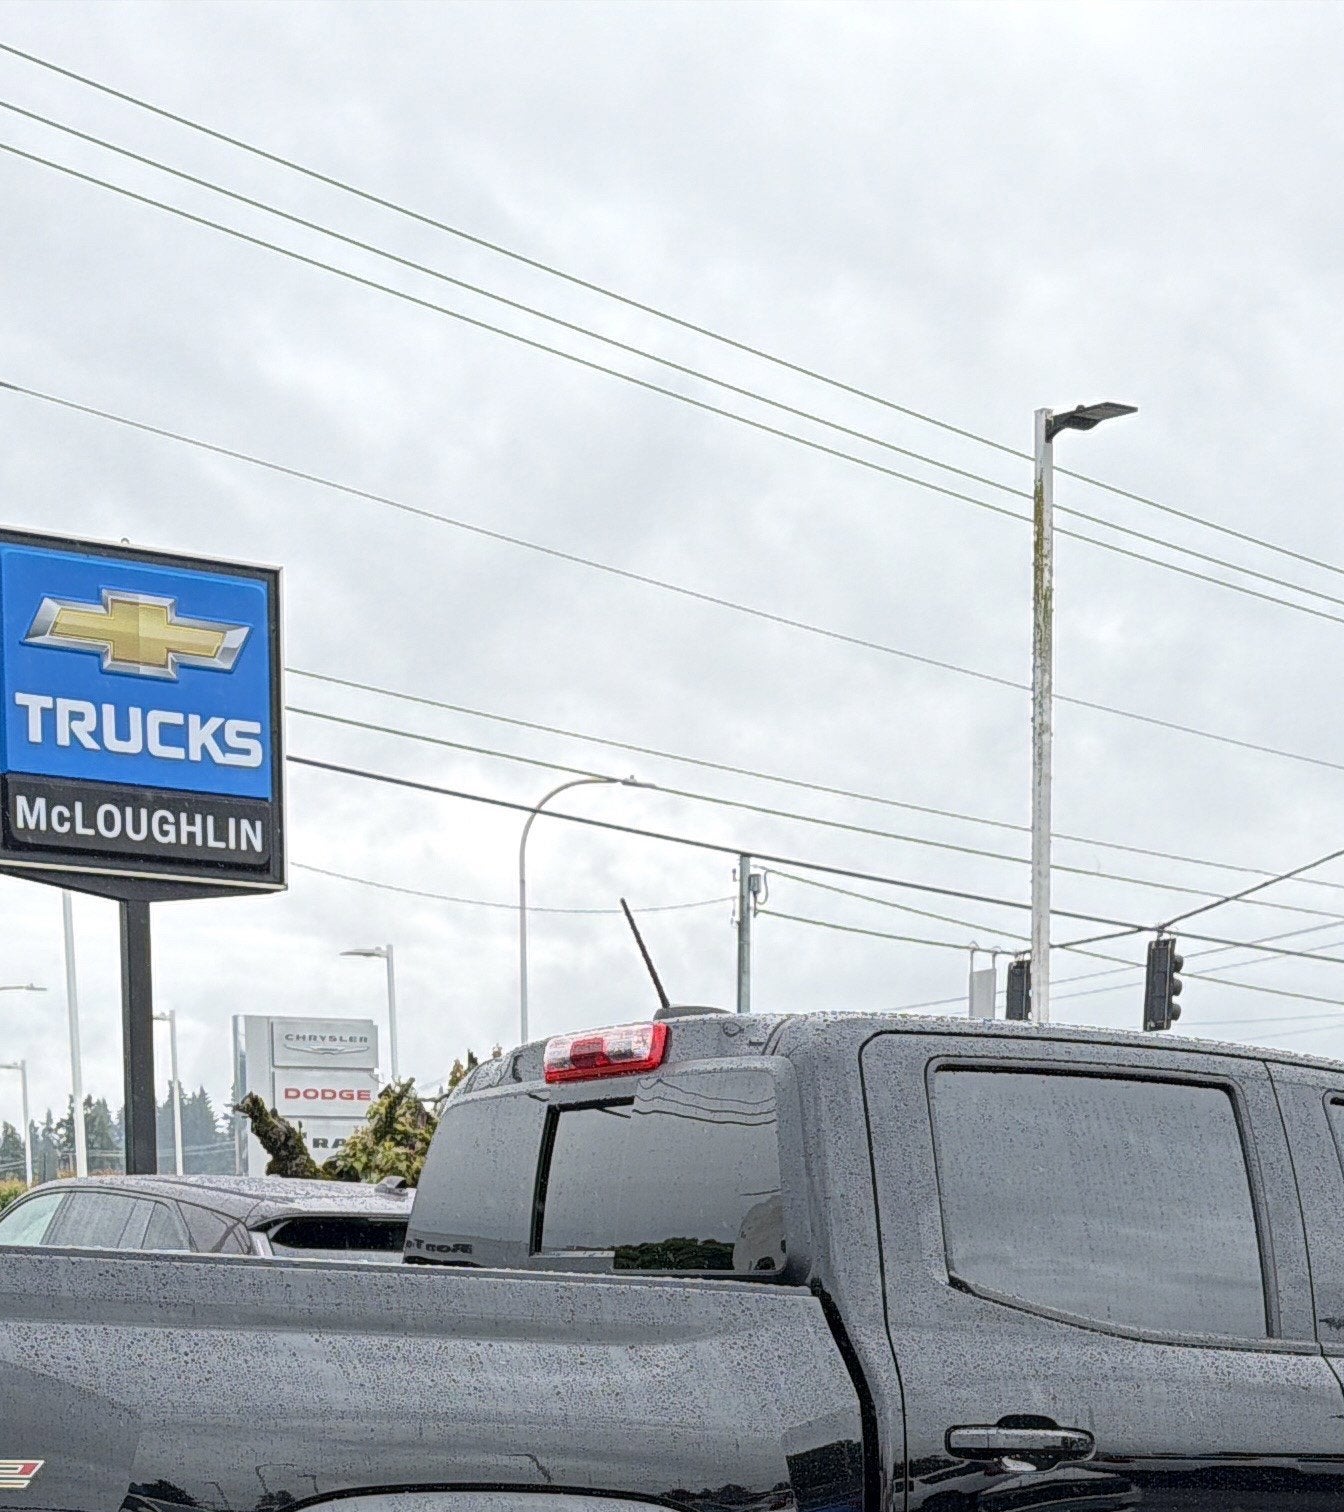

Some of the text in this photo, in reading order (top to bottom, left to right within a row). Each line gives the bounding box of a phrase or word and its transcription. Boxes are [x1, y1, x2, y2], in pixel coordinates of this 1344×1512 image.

[14, 692, 263, 768] TRUCKS
[15, 795, 264, 852] McLOUGHLIN
[284, 1033, 368, 1043] CHRYSLER
[284, 1088, 372, 1101] DODGE
[312, 1137, 347, 1149] RA
